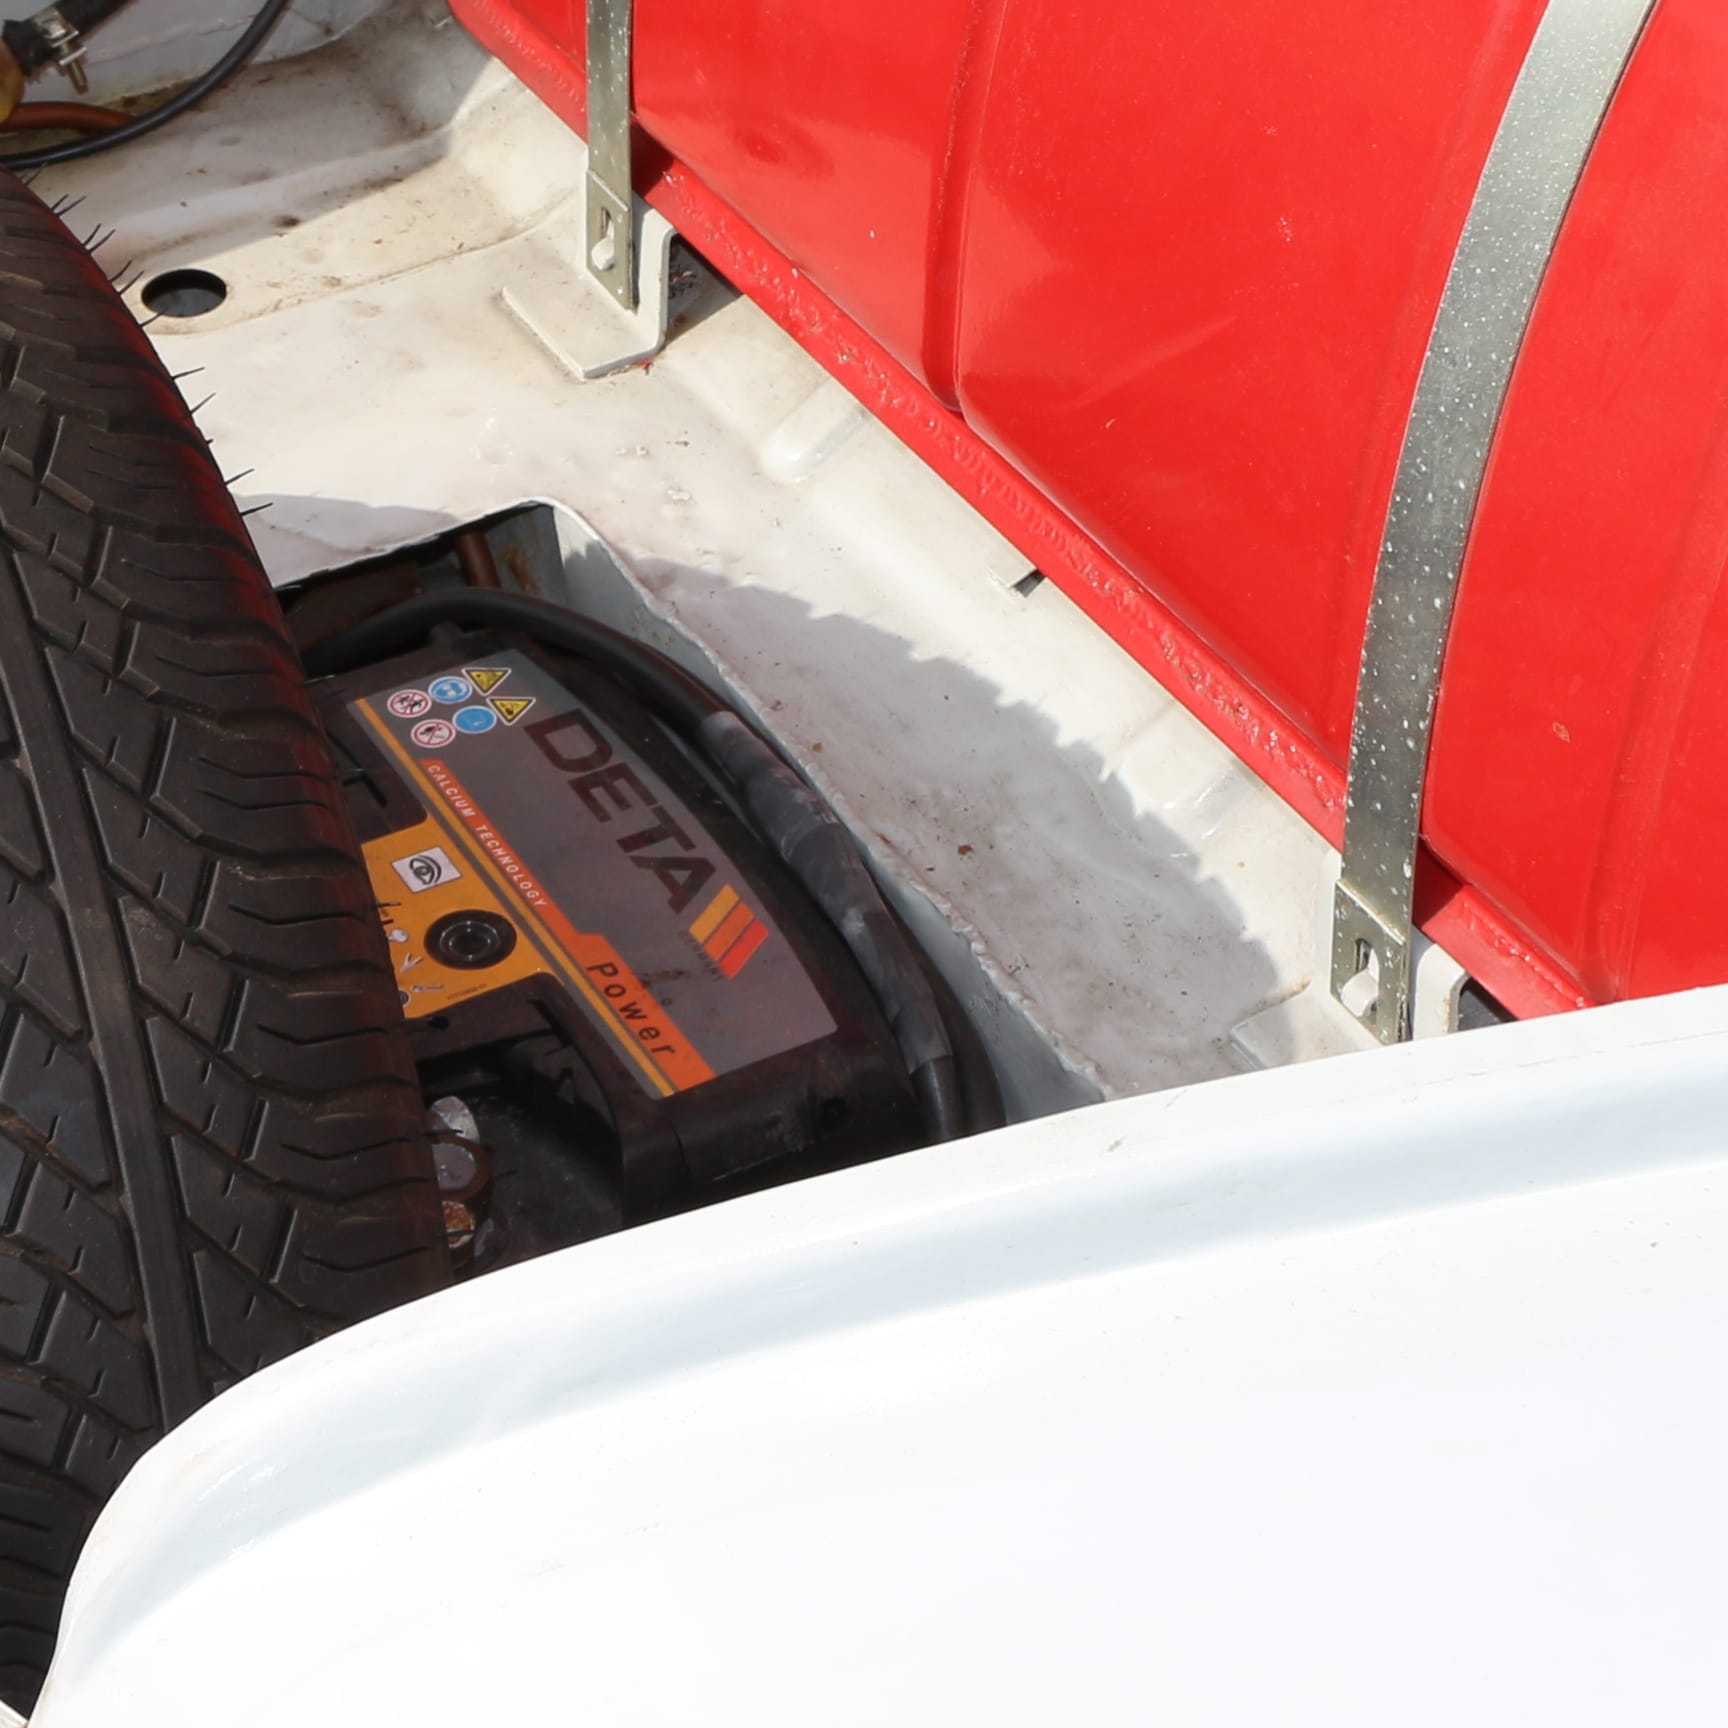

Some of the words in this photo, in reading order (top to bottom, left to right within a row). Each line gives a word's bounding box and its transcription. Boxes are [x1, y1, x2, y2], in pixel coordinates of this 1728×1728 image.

[427, 764, 476, 818] CALCIUM
[474, 823, 548, 907] TECHNOLOGY
[524, 708, 716, 915] DETA
[585, 961, 677, 1055] Power
